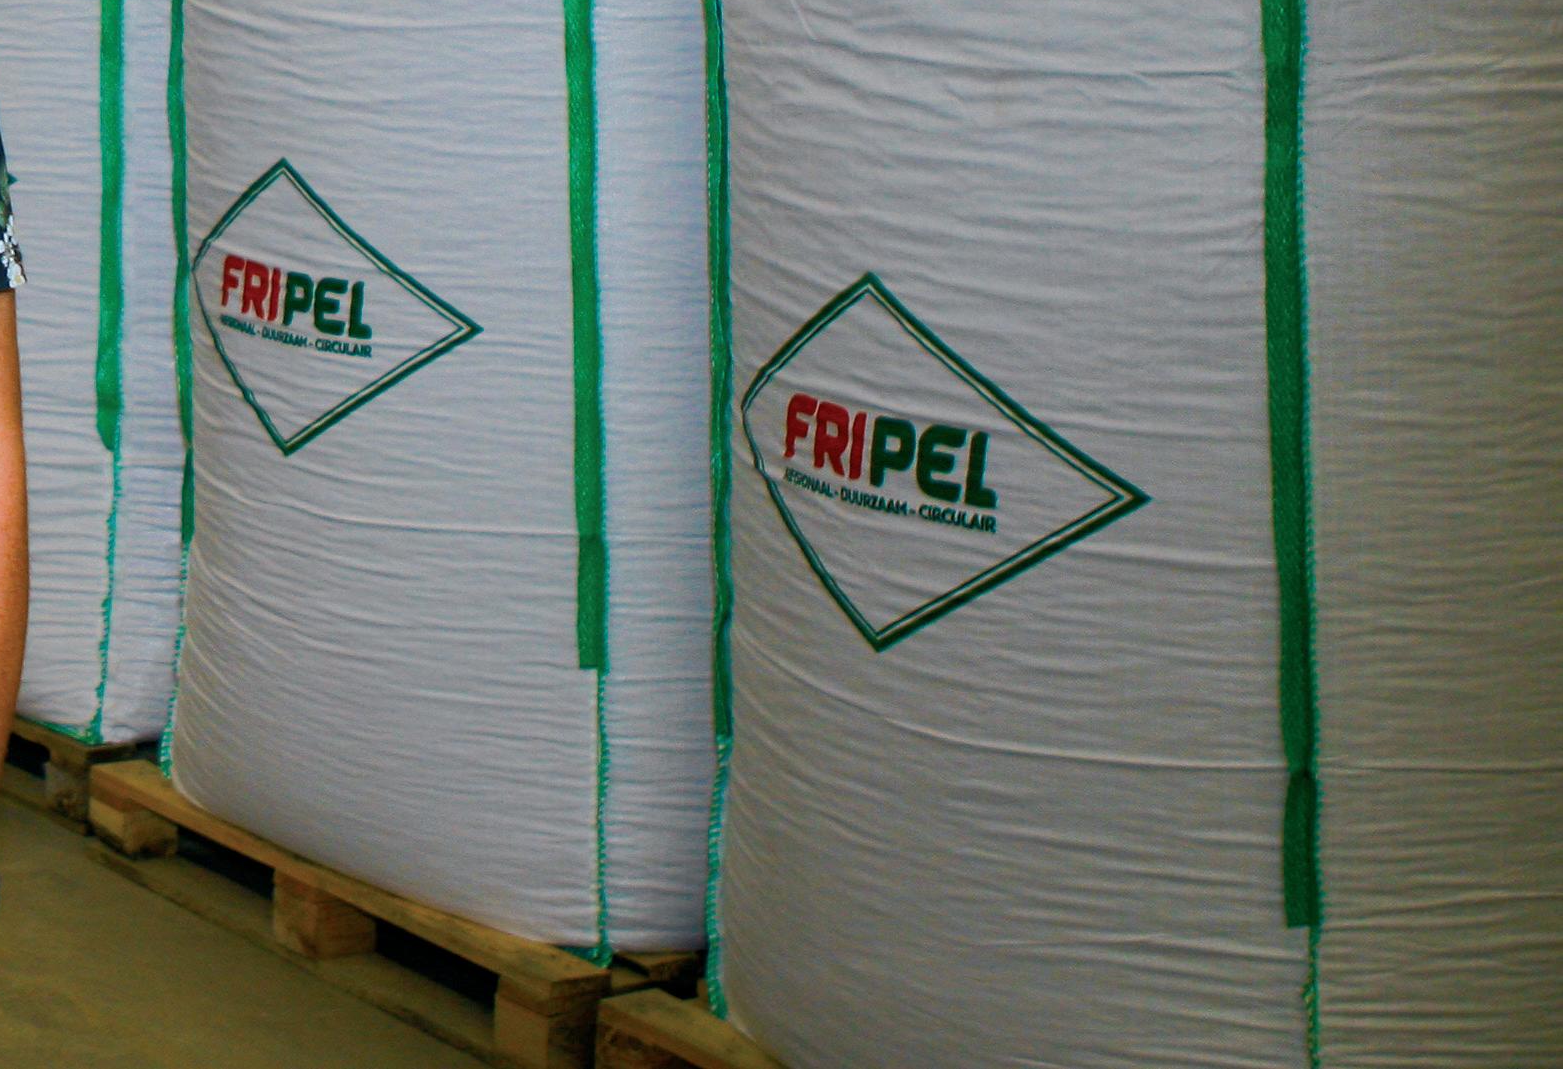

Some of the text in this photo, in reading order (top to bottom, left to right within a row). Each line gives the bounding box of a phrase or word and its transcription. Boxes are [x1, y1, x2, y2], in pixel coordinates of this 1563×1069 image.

[221, 254, 373, 340] FRIPEL
[314, 338, 373, 358] CIRCULAIR
[784, 392, 999, 509] FRIPEL
[840, 486, 908, 516] DUURZAAM
[919, 504, 997, 534] CIRCULAIR
